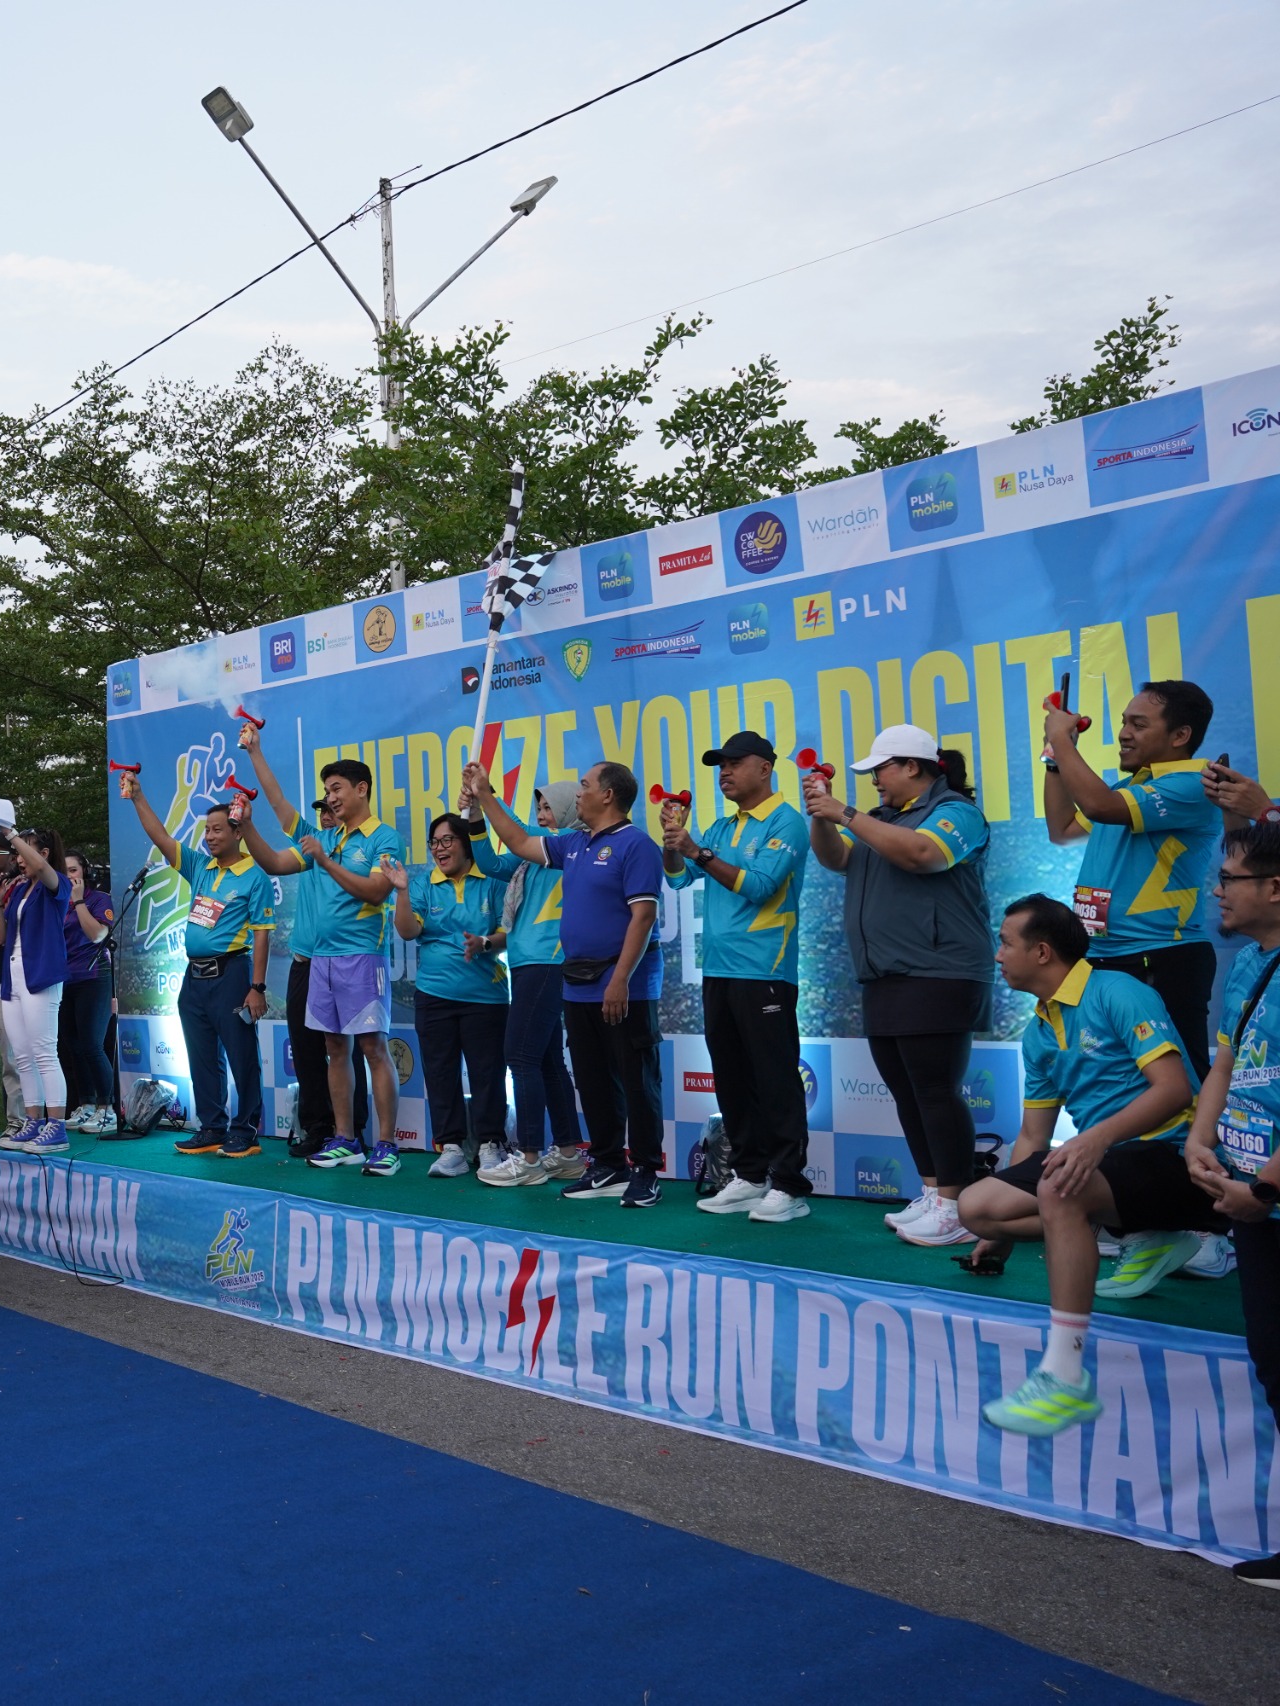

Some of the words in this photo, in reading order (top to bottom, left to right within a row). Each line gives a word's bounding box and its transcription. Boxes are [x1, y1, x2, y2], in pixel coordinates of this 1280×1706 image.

[1096, 451, 1133, 468] SPORTA
[1133, 438, 1188, 458] INDONESIA
[1018, 464, 1055, 483] PLN
[1019, 480, 1045, 494] Nusa
[1047, 473, 1074, 490] Daya
[910, 492, 934, 507] PLN
[912, 500, 954, 518] mobile
[740, 531, 755, 543] CW
[741, 547, 763, 560] FFEE
[661, 556, 698, 571] PRAMITA
[699, 552, 712, 563] Lab
[600, 568, 618, 580] PLN
[547, 582, 578, 596] ASKRINDO
[601, 576, 632, 590] mobile
[839, 587, 908, 623] PLN
[425, 609, 445, 622] PLN
[425, 619, 440, 629] Nusa
[440, 616, 455, 626] Daya
[730, 619, 751, 632] PLN
[731, 628, 767, 642] mobile
[273, 640, 292, 656] BRI
[307, 636, 327, 654] BSI
[614, 644, 647, 658] SPORTA
[647, 634, 696, 652] INDONESIA
[232, 655, 248, 665] PLN
[277, 654, 293, 665] mo
[483, 656, 546, 676] anantara
[490, 671, 542, 691] ndonesia
[593, 678, 801, 850] YOUR
[1152, 793, 1168, 817] PLN
[950, 829, 969, 853] PLN
[779, 842, 798, 857] PLN
[1074, 902, 1097, 919] 0036
[685, 1077, 715, 1089] PRAMI
[1243, 1070, 1261, 1081] RUN
[840, 1077, 890, 1097] War
[966, 1095, 1002, 1109] bile
[276, 1115, 292, 1130] BS
[1226, 1127, 1265, 1154] 56160
[857, 1171, 881, 1183] PLN
[858, 1182, 900, 1196] mobile
[205, 1247, 256, 1278] PLN
[220, 1276, 240, 1289] MOBILE
[240, 1274, 251, 1285] RUN
[220, 1294, 262, 1311] PONTIANAK
[288, 1209, 387, 1342] PLN
[391, 1227, 610, 1398] MOBILE
[624, 1263, 776, 1436] RUN
[795, 1288, 1280, 1554] PONTAN
